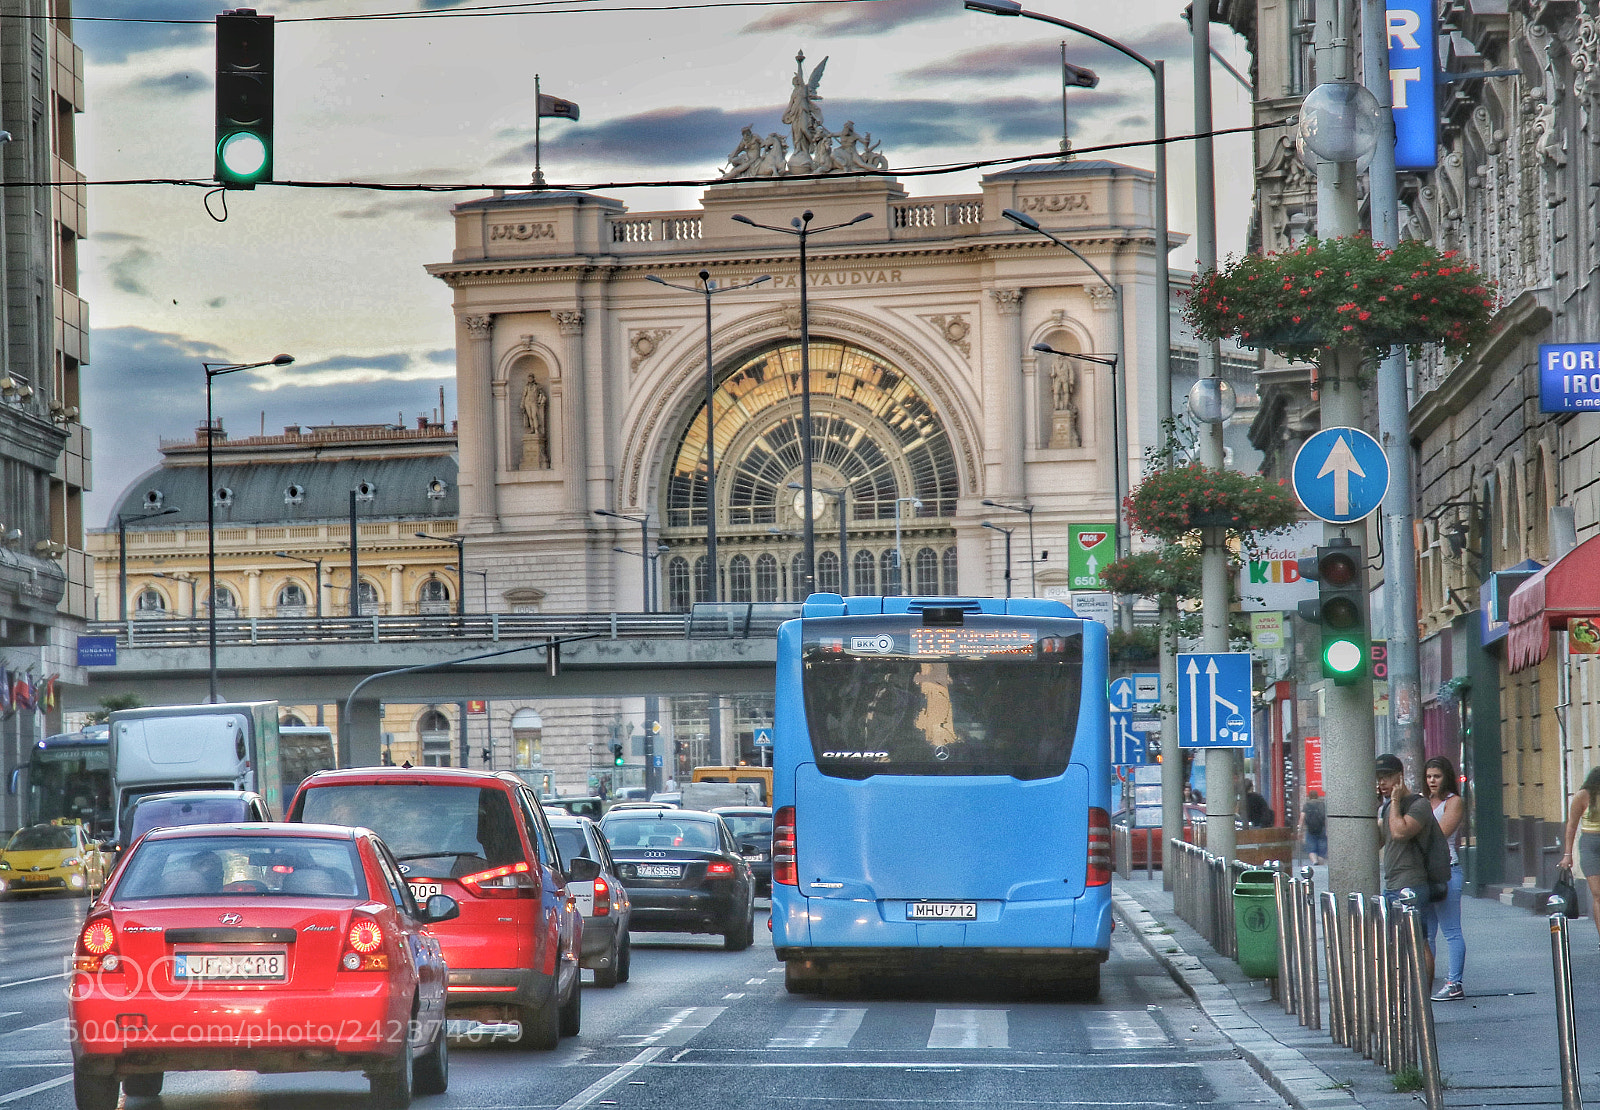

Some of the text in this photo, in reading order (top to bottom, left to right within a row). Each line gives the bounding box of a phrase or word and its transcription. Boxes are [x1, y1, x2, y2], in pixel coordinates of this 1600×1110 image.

[773, 269, 903, 288] PÁYAUDVAR
[1081, 534, 1098, 542] MOL
[1074, 576, 1096, 586] 650
[857, 640, 875, 648] BKK
[916, 905, 973, 916] MHU-712
